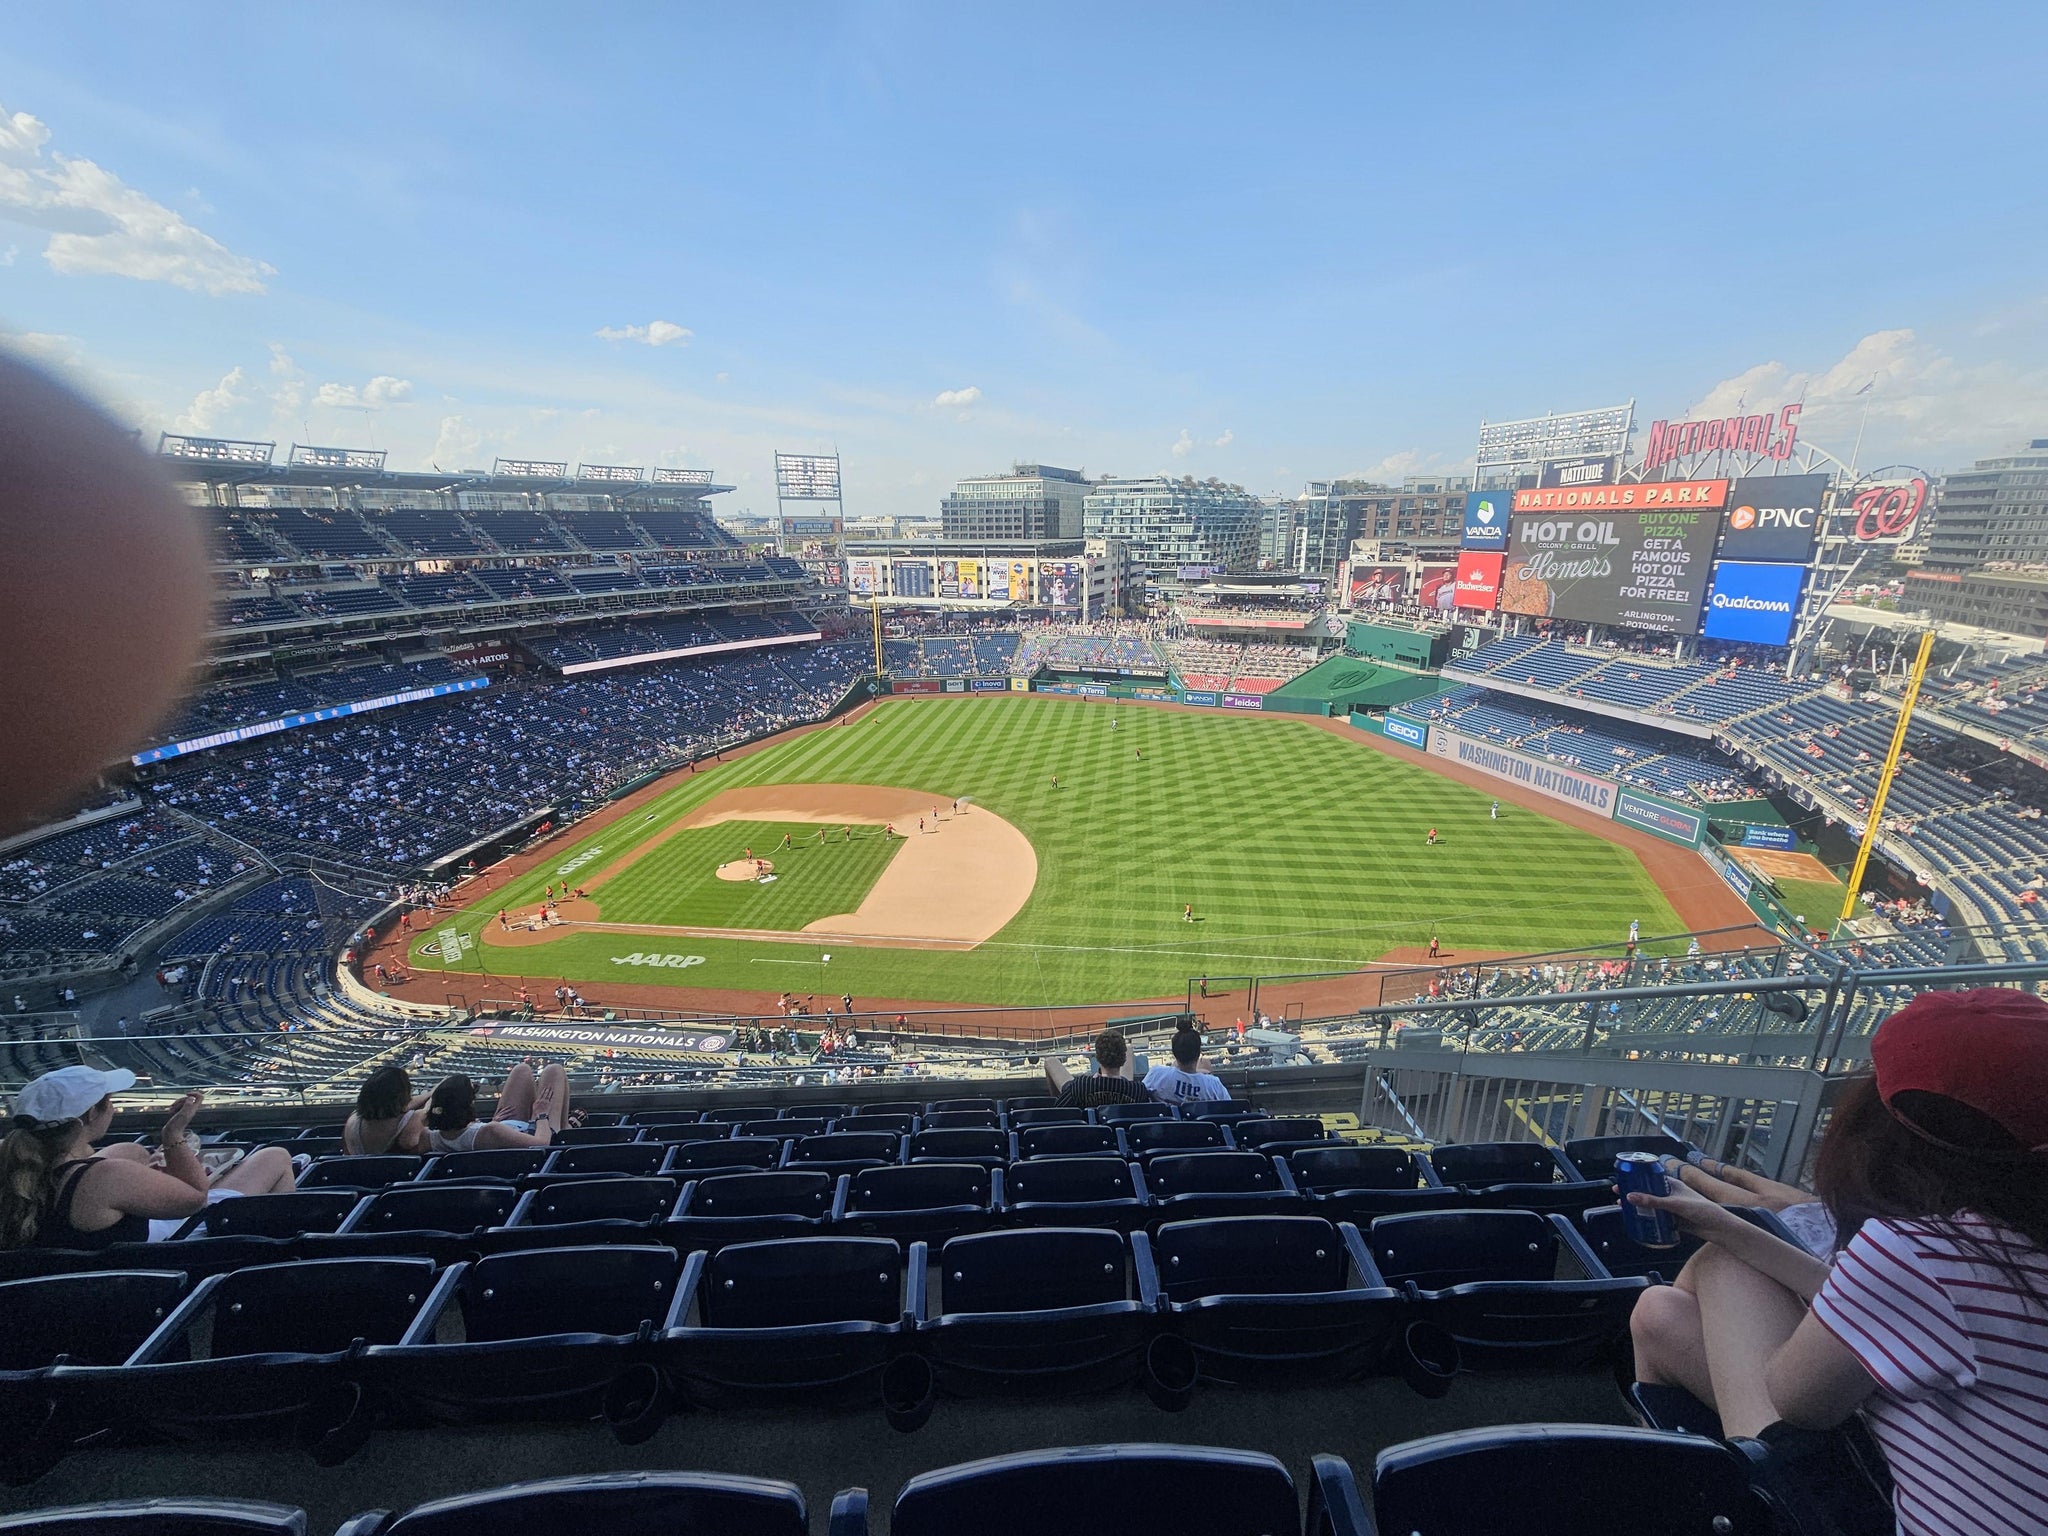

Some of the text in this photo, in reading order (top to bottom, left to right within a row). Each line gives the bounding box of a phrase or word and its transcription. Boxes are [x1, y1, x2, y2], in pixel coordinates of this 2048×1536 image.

[1644, 403, 1803, 469] NATIONALS
[1560, 463, 1604, 483] NATITUDE
[1520, 486, 1712, 507] NATIONALS PARK
[1638, 513, 1700, 524] BUY ONE
[1758, 507, 1814, 528] PNC
[1465, 526, 1502, 536] VANDA
[1521, 522, 1620, 546] HOT OIL
[1643, 526, 1688, 540] PIZZA,
[1643, 539, 1682, 550] GET A
[1631, 551, 1691, 563] FAMOUS
[1518, 551, 1611, 580] Homers
[1631, 563, 1685, 576] HOT OIL
[1456, 580, 1494, 593] Budweiser
[1635, 576, 1675, 588] PIZZA
[1619, 586, 1690, 601] FOR FREE!
[1712, 593, 1790, 612] Qualcomm
[480, 652, 509, 664] ARTOIS
[1086, 687, 1105, 695] Terra
[351, 688, 434, 713] WASHINGTON NATIONALS
[1234, 697, 1260, 707] leidos
[177, 719, 285, 753] WASHINGTON NATIONALS
[1388, 722, 1418, 739] GEICO
[1458, 741, 1532, 782] WASHINGTON
[1533, 766, 1609, 809] NATIONALS
[1624, 803, 1692, 832] VENTURE GLOBAL
[1761, 835, 1789, 843] breathe
[610, 952, 706, 968] AARP
[500, 1026, 605, 1041] WASHINGTON
[604, 1034, 696, 1047] NATIONALS
[1174, 1080, 1200, 1098] Lite
